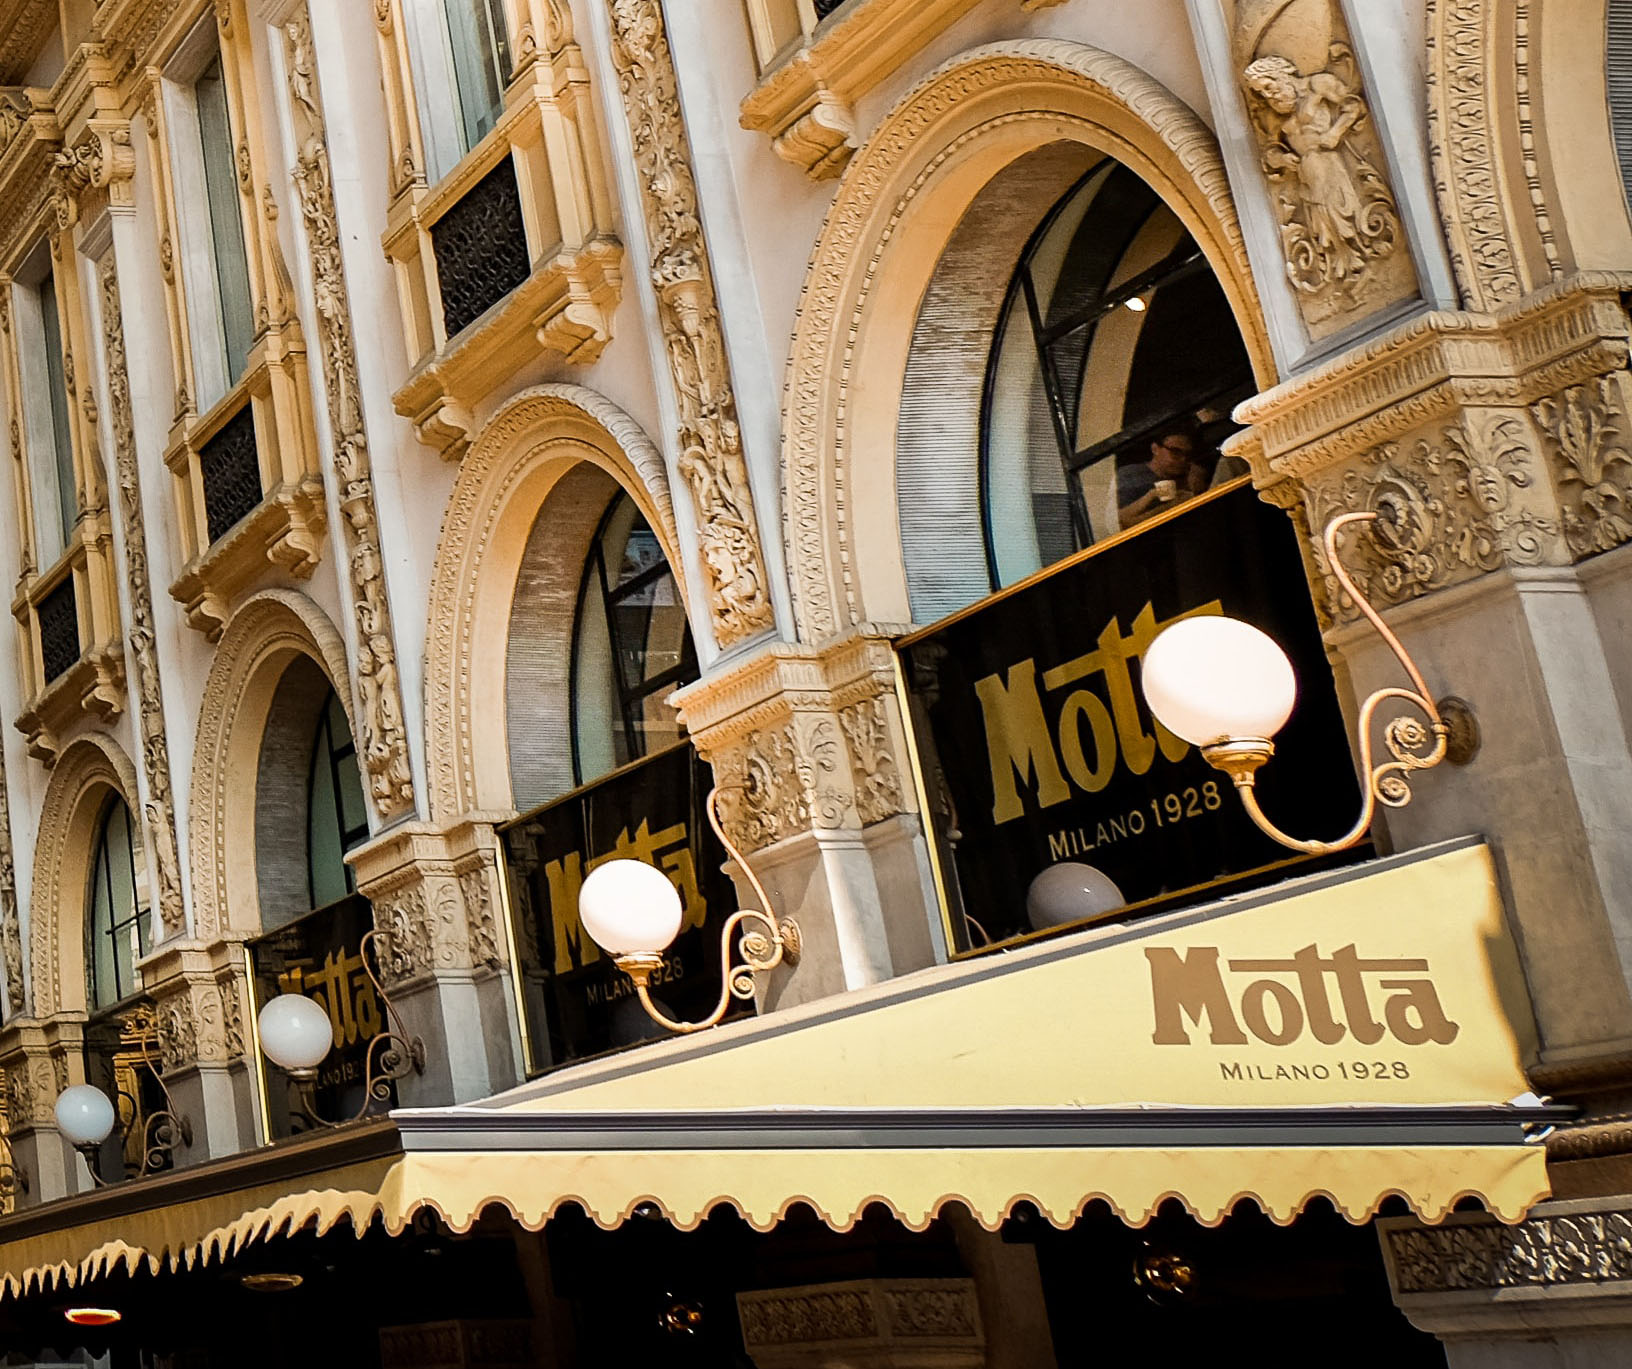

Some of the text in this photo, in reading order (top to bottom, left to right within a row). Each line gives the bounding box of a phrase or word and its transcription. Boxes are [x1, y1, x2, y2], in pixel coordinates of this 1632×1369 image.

[974, 599, 1224, 825] Mott
[1048, 781, 1222, 861] MILANO 1928
[647, 957, 684, 986] 928
[1144, 943, 1460, 1046] Motta
[1220, 1061, 1410, 1080] MILANO 1928
